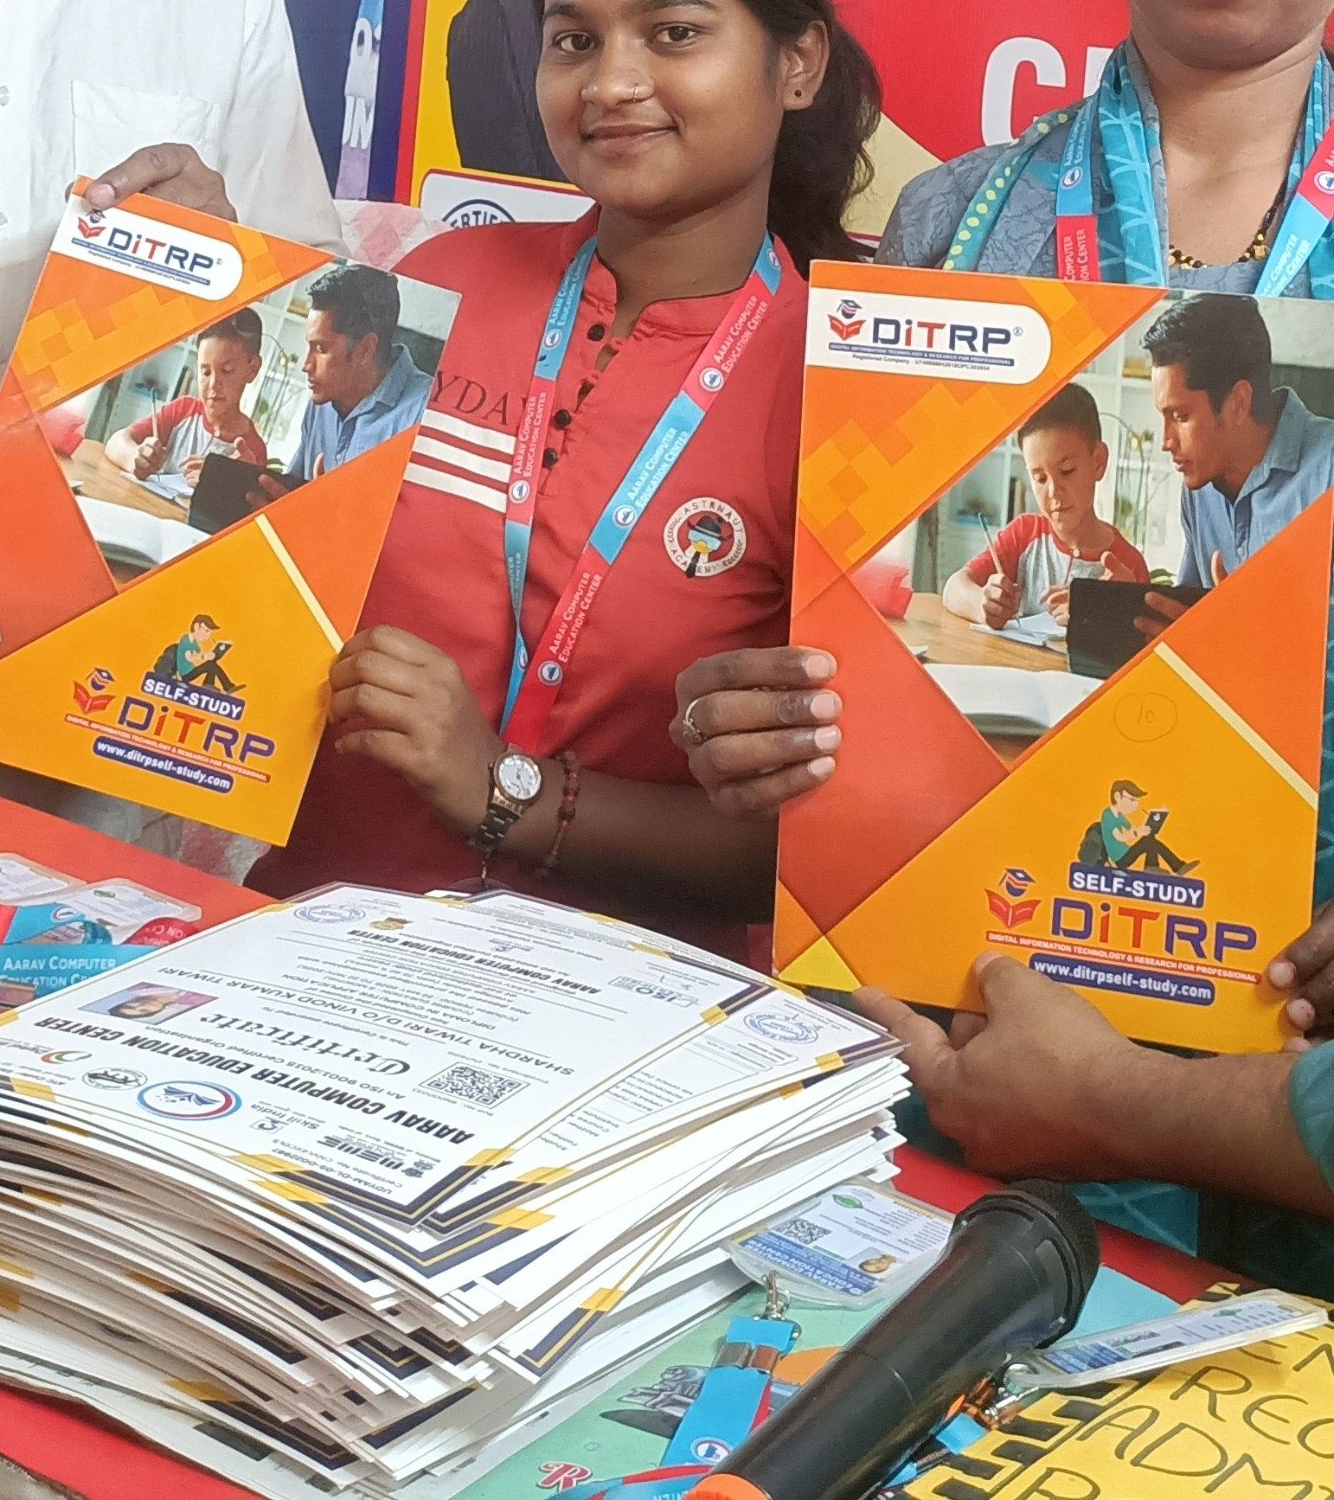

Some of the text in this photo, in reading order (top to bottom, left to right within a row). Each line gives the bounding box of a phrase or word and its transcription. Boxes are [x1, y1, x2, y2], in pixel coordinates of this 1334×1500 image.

[1075, 227, 1088, 263] CENTER
[712, 295, 758, 364] AARAV COMPUTER
[721, 299, 769, 374] EDUCATION CENTER
[513, 395, 538, 475] AARAV COMPUTER
[522, 392, 547, 478] EDUCATION CENTER
[626, 426, 679, 501] AARAV COMPUTER
[634, 429, 690, 511] EDUCATION CENTER
[548, 571, 592, 655] AARAV COMPUTER
[558, 573, 604, 664] EDUCATION CENTER
[143, 678, 242, 719] SELF-STUDY
[1073, 871, 1202, 906] SELF-STUDY
[346, 929, 398, 943] CENTER
[399, 940, 473, 961] EDUCATION
[2, 956, 116, 971] AARAV COMPUTER
[473, 958, 551, 980] COMPUTER
[988, 932, 1019, 945] DIGITAL
[1020, 936, 1072, 953] INFORMATION
[1073, 943, 1127, 962] TECHNOLOGY
[1134, 955, 1177, 970] RESEARCH
[1195, 964, 1257, 982] PROFESSIONAL
[158, 965, 223, 985] TIWARI
[225, 979, 293, 1000] KUMAR
[551, 978, 602, 993] AARAV
[1034, 959, 1212, 1000] www.ditrpself-study.com
[293, 995, 359, 1015] VINOD
[358, 1010, 405, 1025] D/O
[35, 1014, 125, 1042] CENTER
[143, 1025, 224, 1048] Organization
[198, 1014, 408, 1074] Certificate
[400, 1022, 475, 1044] TIWARI
[123, 1036, 249, 1072] EDUCATION
[223, 1045, 286, 1064] Certified
[473, 1043, 577, 1073] SHARDHA
[245, 1070, 387, 1113] COMPUTER
[354, 1083, 386, 1093] ISO
[245, 1103, 323, 1129] Skill India
[379, 1109, 478, 1143] AARAV
